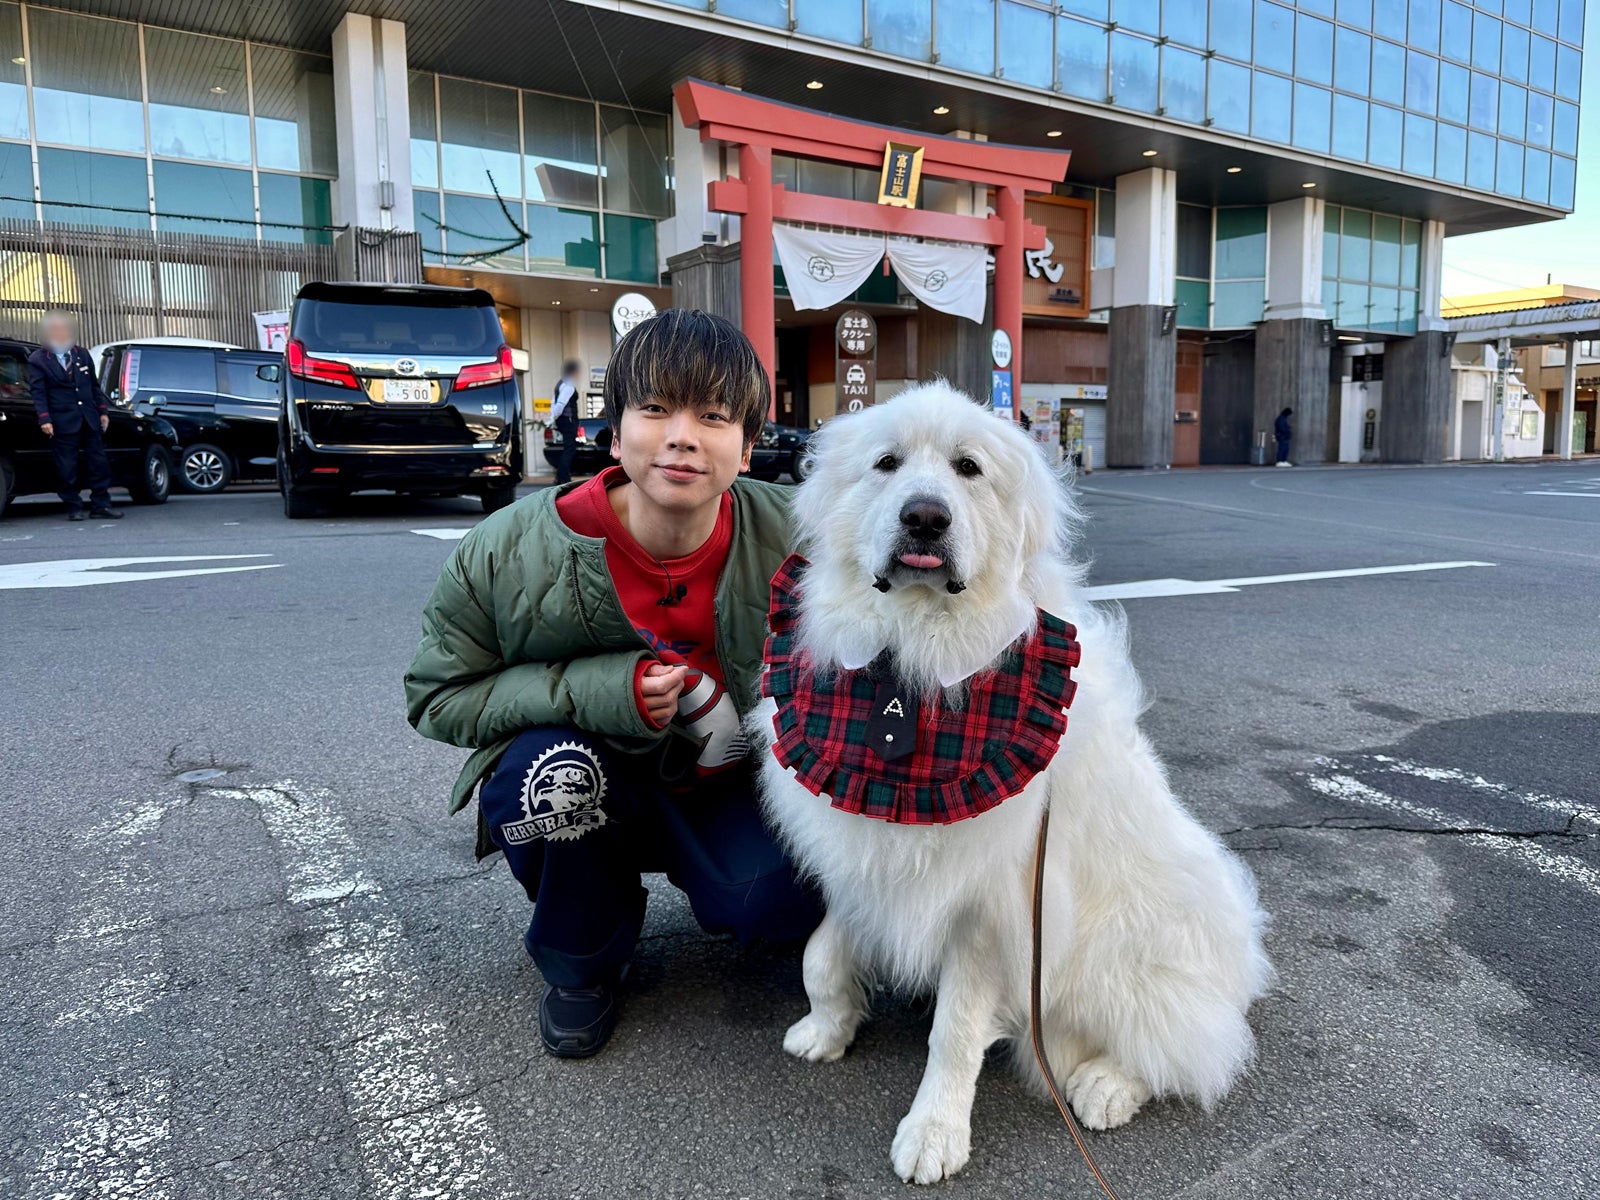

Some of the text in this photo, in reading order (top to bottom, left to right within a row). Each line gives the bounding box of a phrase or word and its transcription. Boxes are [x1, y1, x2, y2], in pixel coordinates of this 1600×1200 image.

[890, 153, 909, 197] 富士山駅
[844, 317, 869, 328] 富士急
[841, 329, 871, 339] タクシー
[847, 340, 865, 351] 専用
[843, 385, 868, 395] TAXI
[848, 399, 864, 412] の
[882, 697, 904, 718] A
[506, 813, 569, 841] CARRERA
